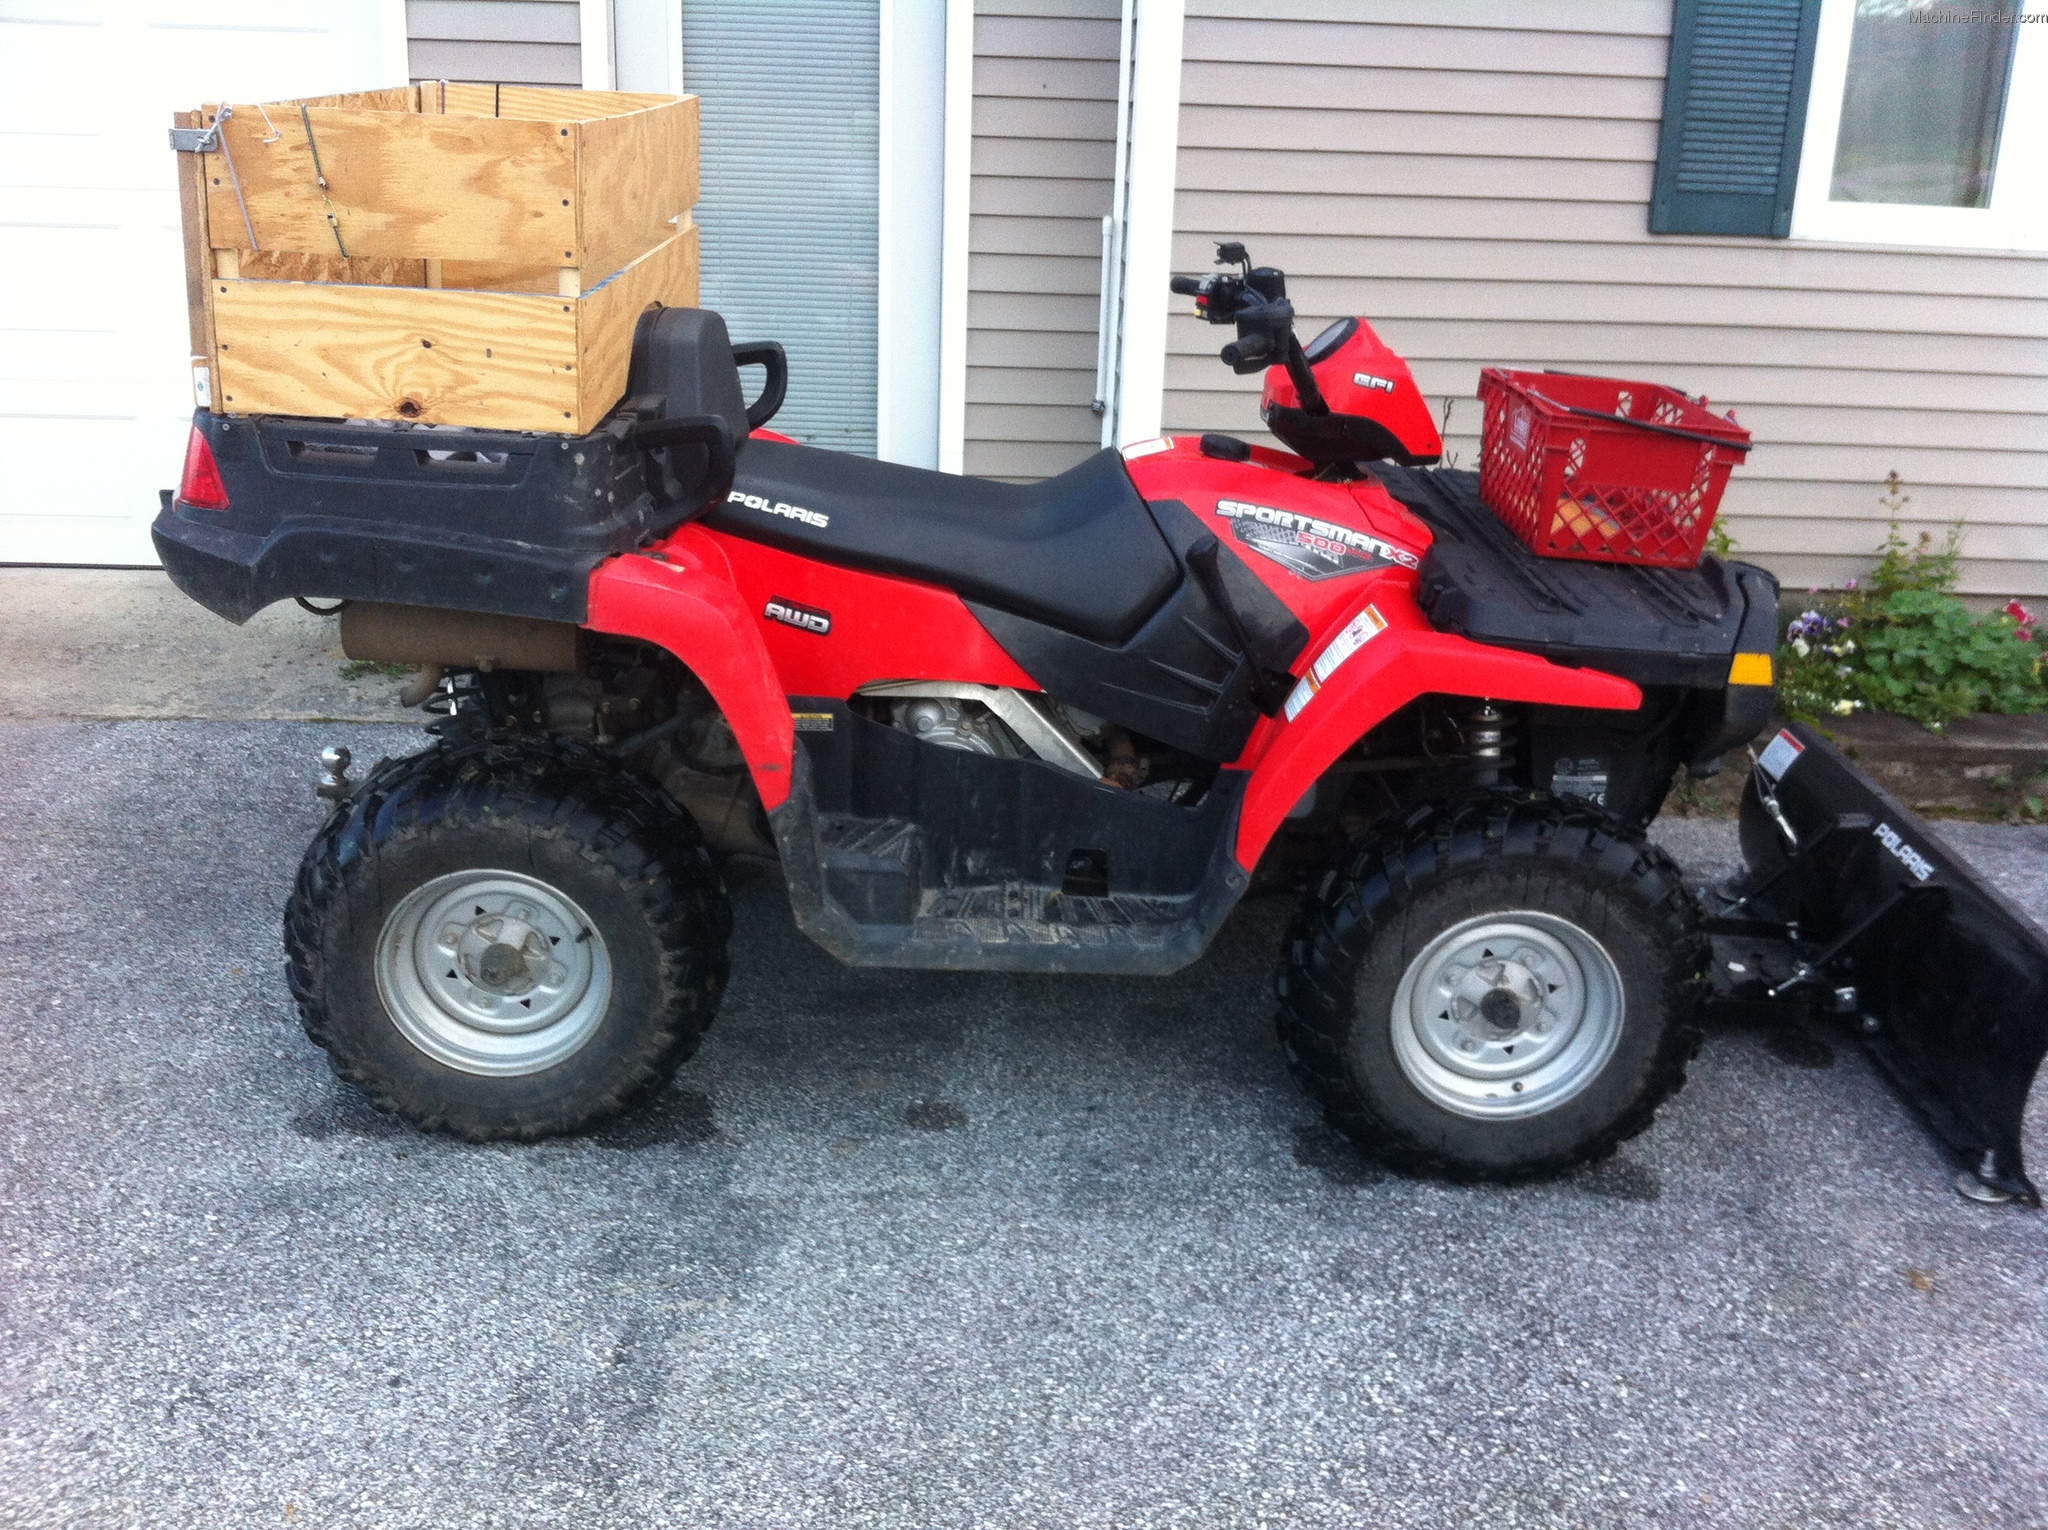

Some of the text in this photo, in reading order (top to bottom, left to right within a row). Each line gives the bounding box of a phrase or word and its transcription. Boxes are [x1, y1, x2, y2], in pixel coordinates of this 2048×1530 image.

[727, 491, 829, 528] POLARIS
[1297, 531, 1346, 555] 500
[764, 602, 830, 633] AWD
[1873, 823, 1935, 881] POLARIS
